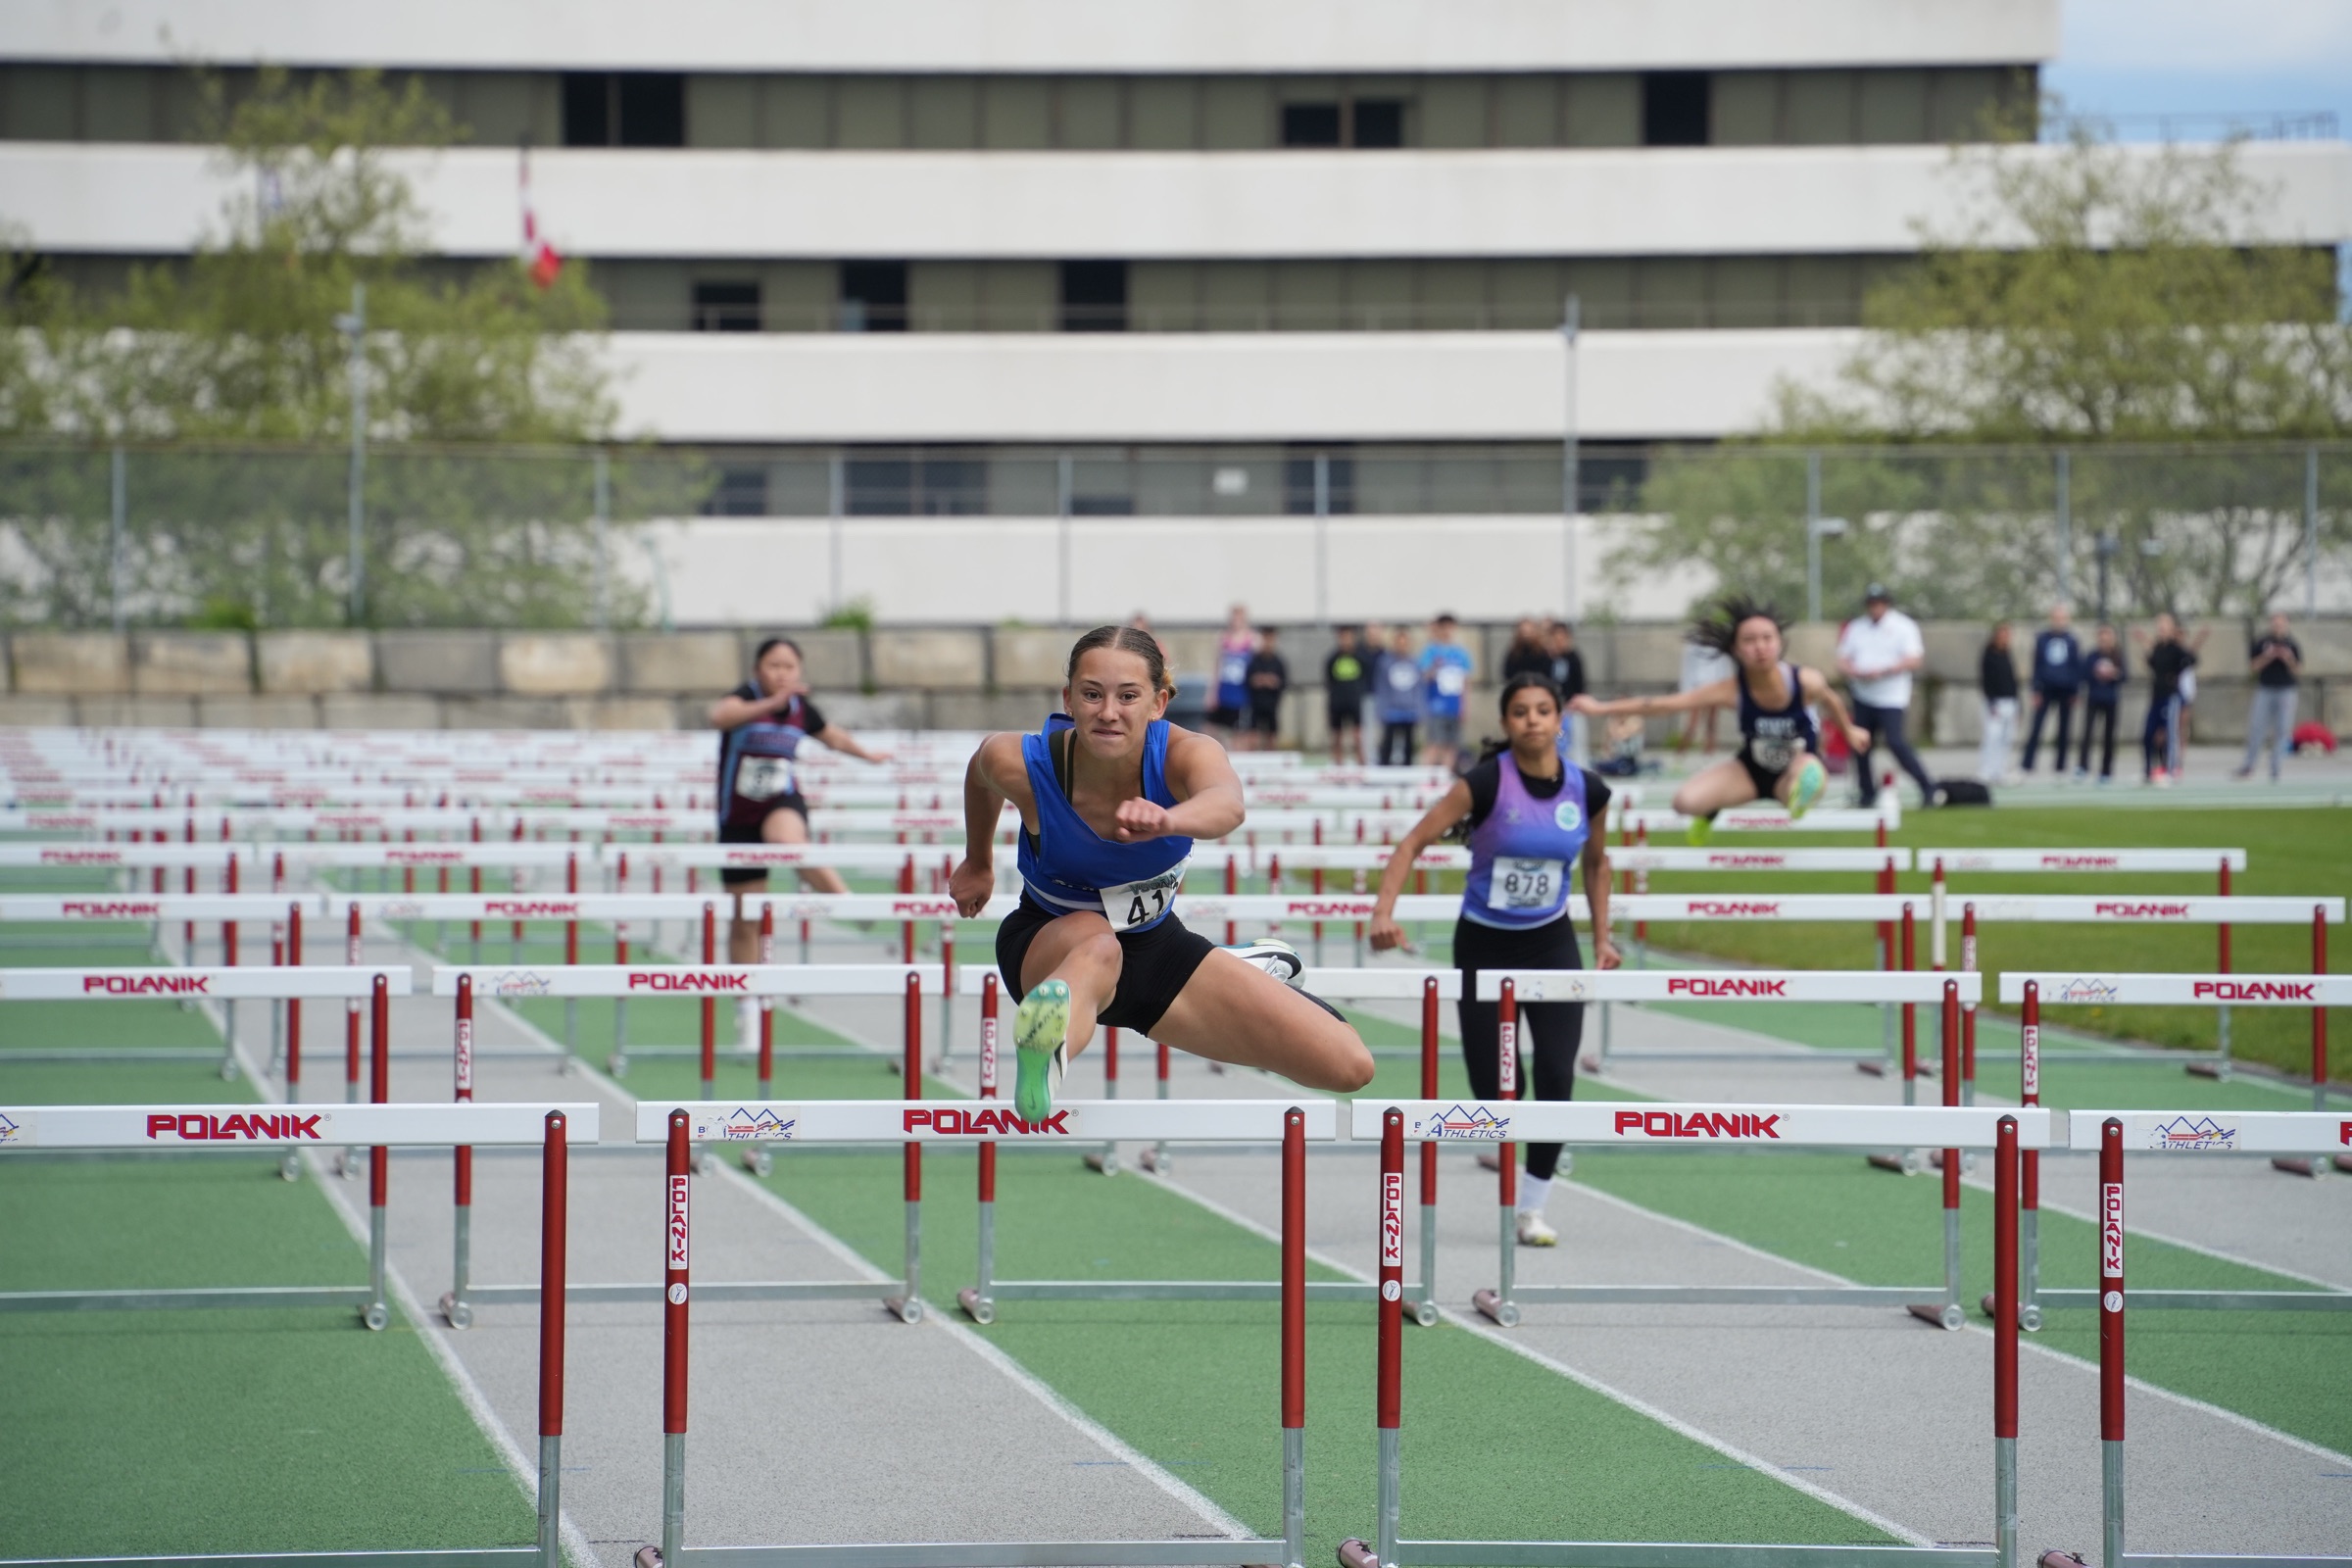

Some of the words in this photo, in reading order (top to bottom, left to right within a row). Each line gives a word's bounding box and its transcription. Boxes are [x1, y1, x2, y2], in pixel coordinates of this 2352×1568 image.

[1504, 873, 1549, 896] 878
[84, 976, 208, 994] POLANIK
[628, 972, 748, 991] POLANIK
[1668, 977, 1787, 997] POLANIK
[2193, 982, 2315, 1000] POLANIK
[147, 1114, 322, 1140] POLANIK
[1430, 1122, 1507, 1139] ATHLETICS
[1614, 1110, 1782, 1140] POLANIK
[670, 1177, 687, 1262] POLANIK
[1385, 1175, 1400, 1259] POLANIK
[2105, 1185, 2122, 1270] POLANIK
